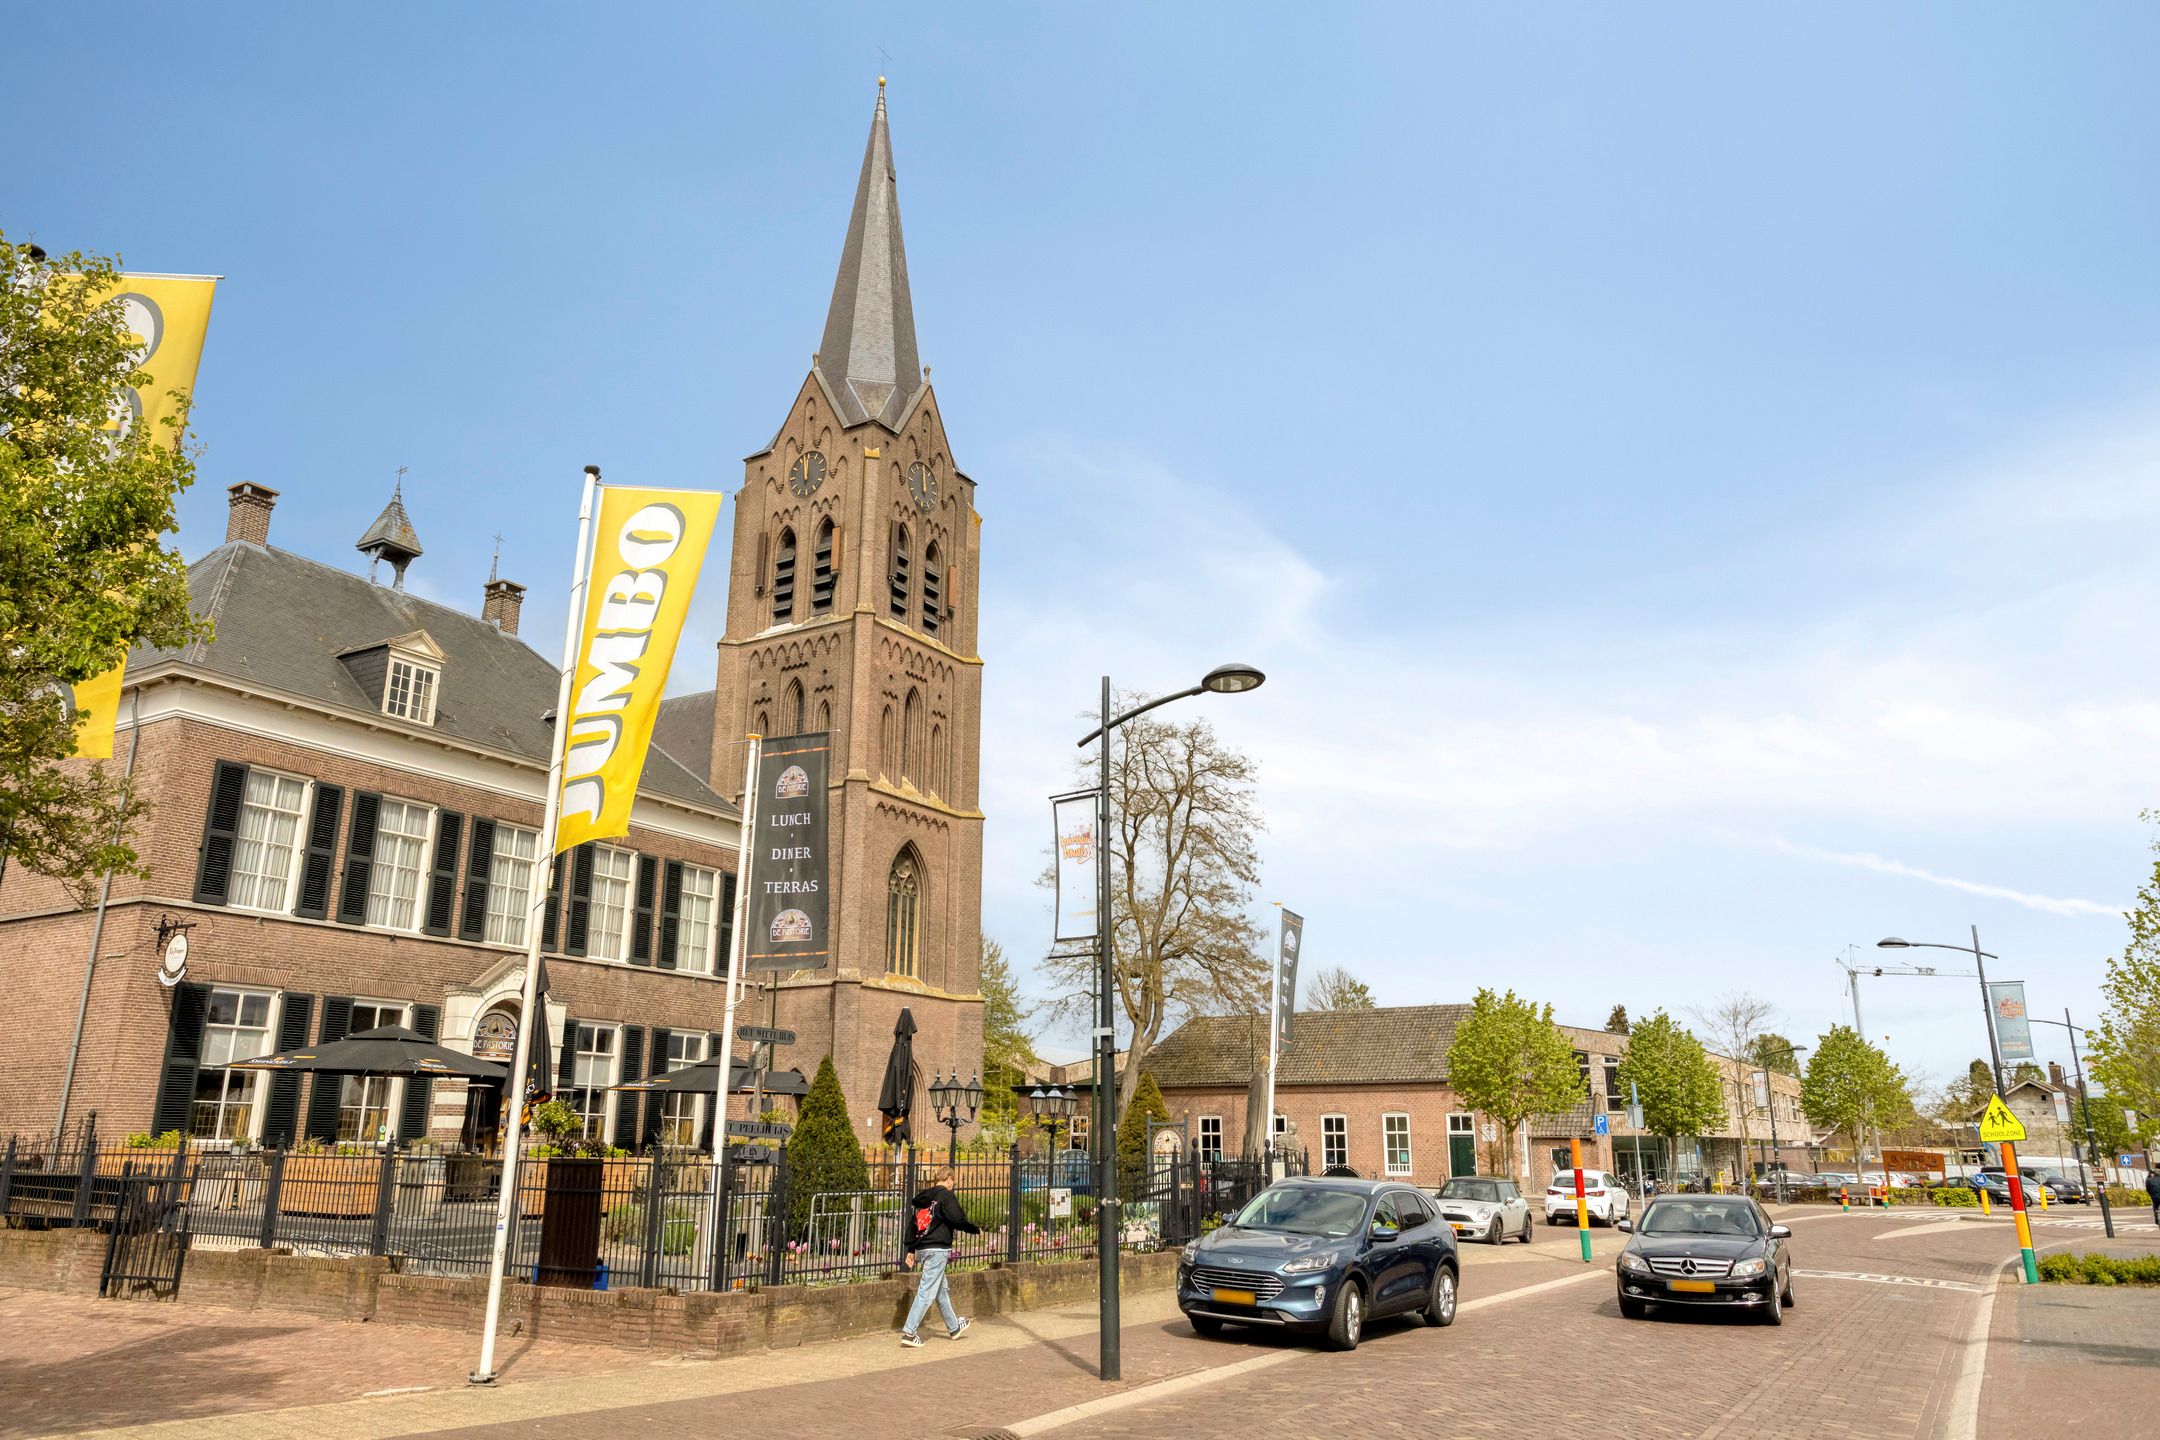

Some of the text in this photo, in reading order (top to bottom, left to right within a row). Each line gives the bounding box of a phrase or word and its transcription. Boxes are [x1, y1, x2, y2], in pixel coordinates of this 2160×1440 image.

[560, 502, 686, 825] JUMBO
[771, 812, 811, 827] LUNCH
[771, 847, 812, 860] DINER
[763, 880, 819, 894] TERRAS
[473, 1040, 514, 1051] DE PASTORIE
[1597, 1116, 1605, 1127] P
